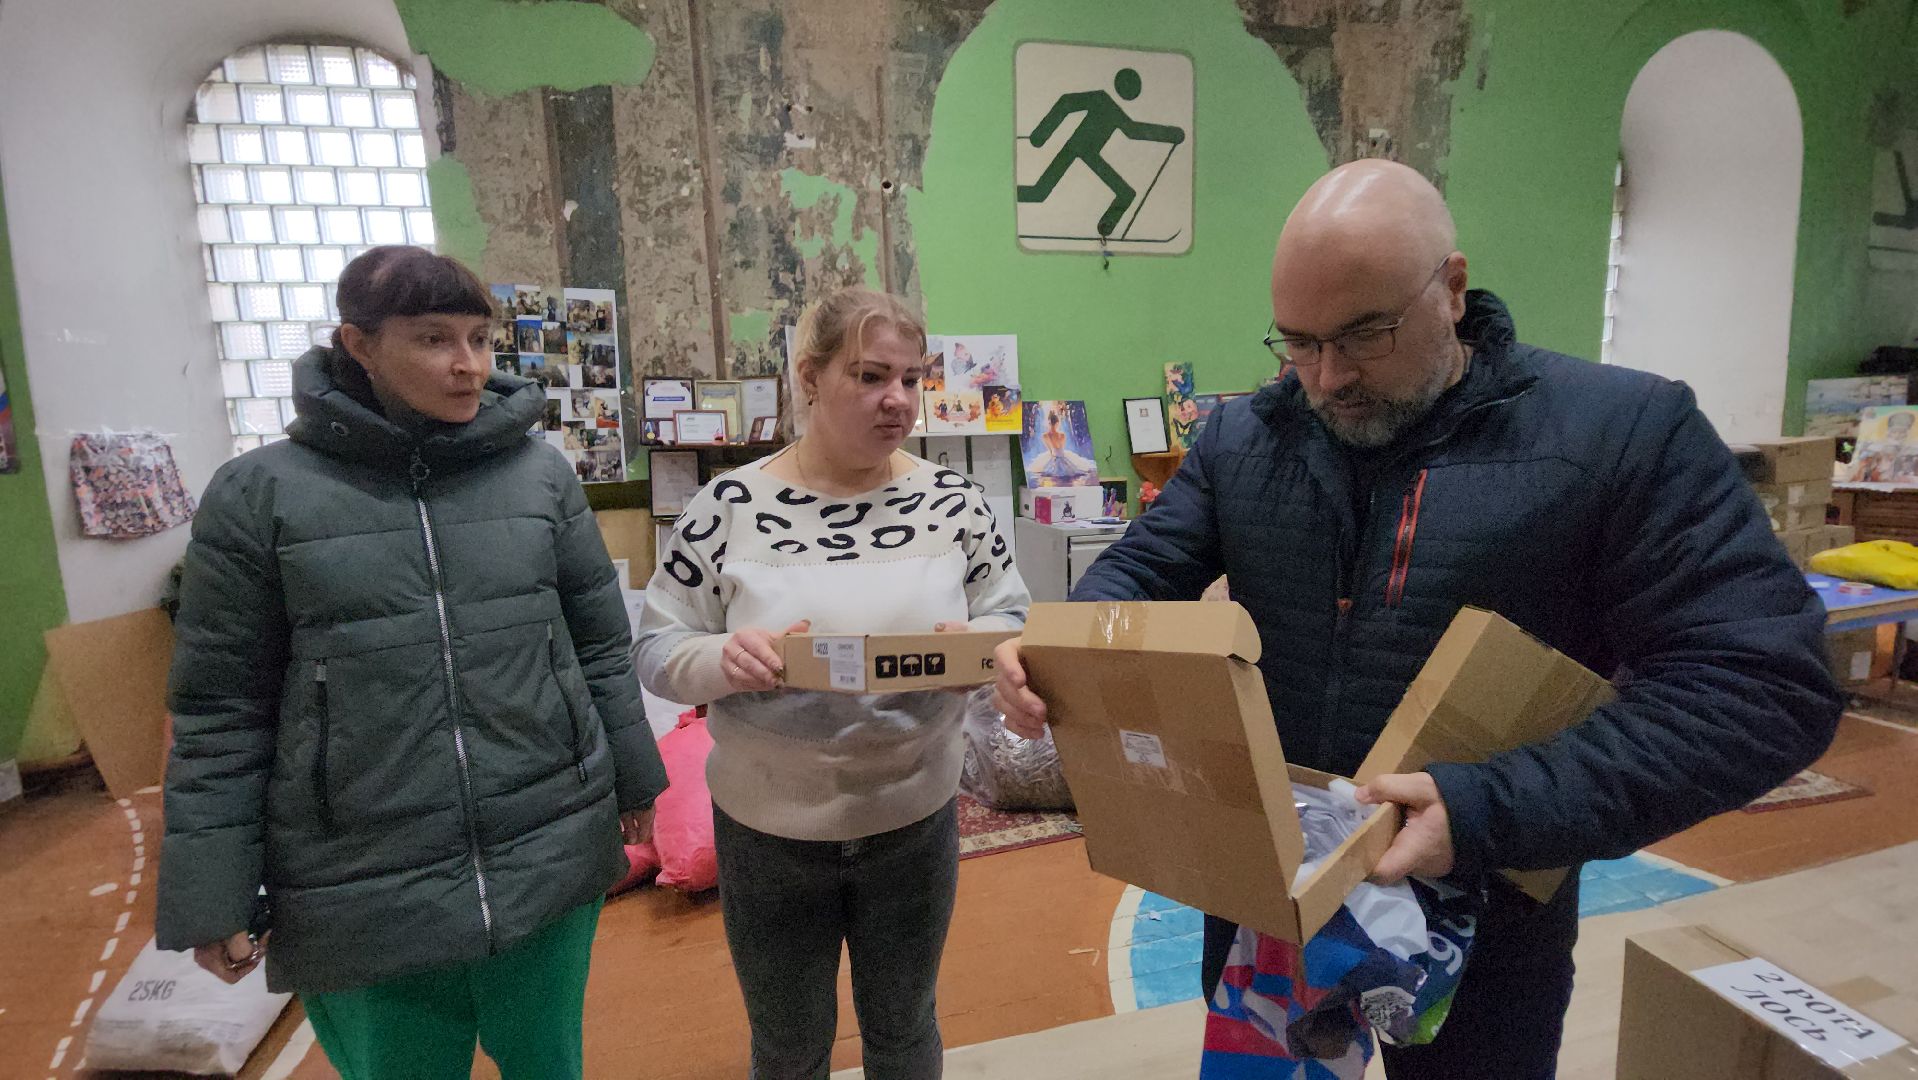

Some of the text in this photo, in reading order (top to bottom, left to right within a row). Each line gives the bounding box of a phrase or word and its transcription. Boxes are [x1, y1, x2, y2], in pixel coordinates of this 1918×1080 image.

[128, 979, 177, 1002] 25KG
[1730, 985, 1828, 1042] ЛОСЬ
[1753, 972, 1876, 1040] 2 РОТА
